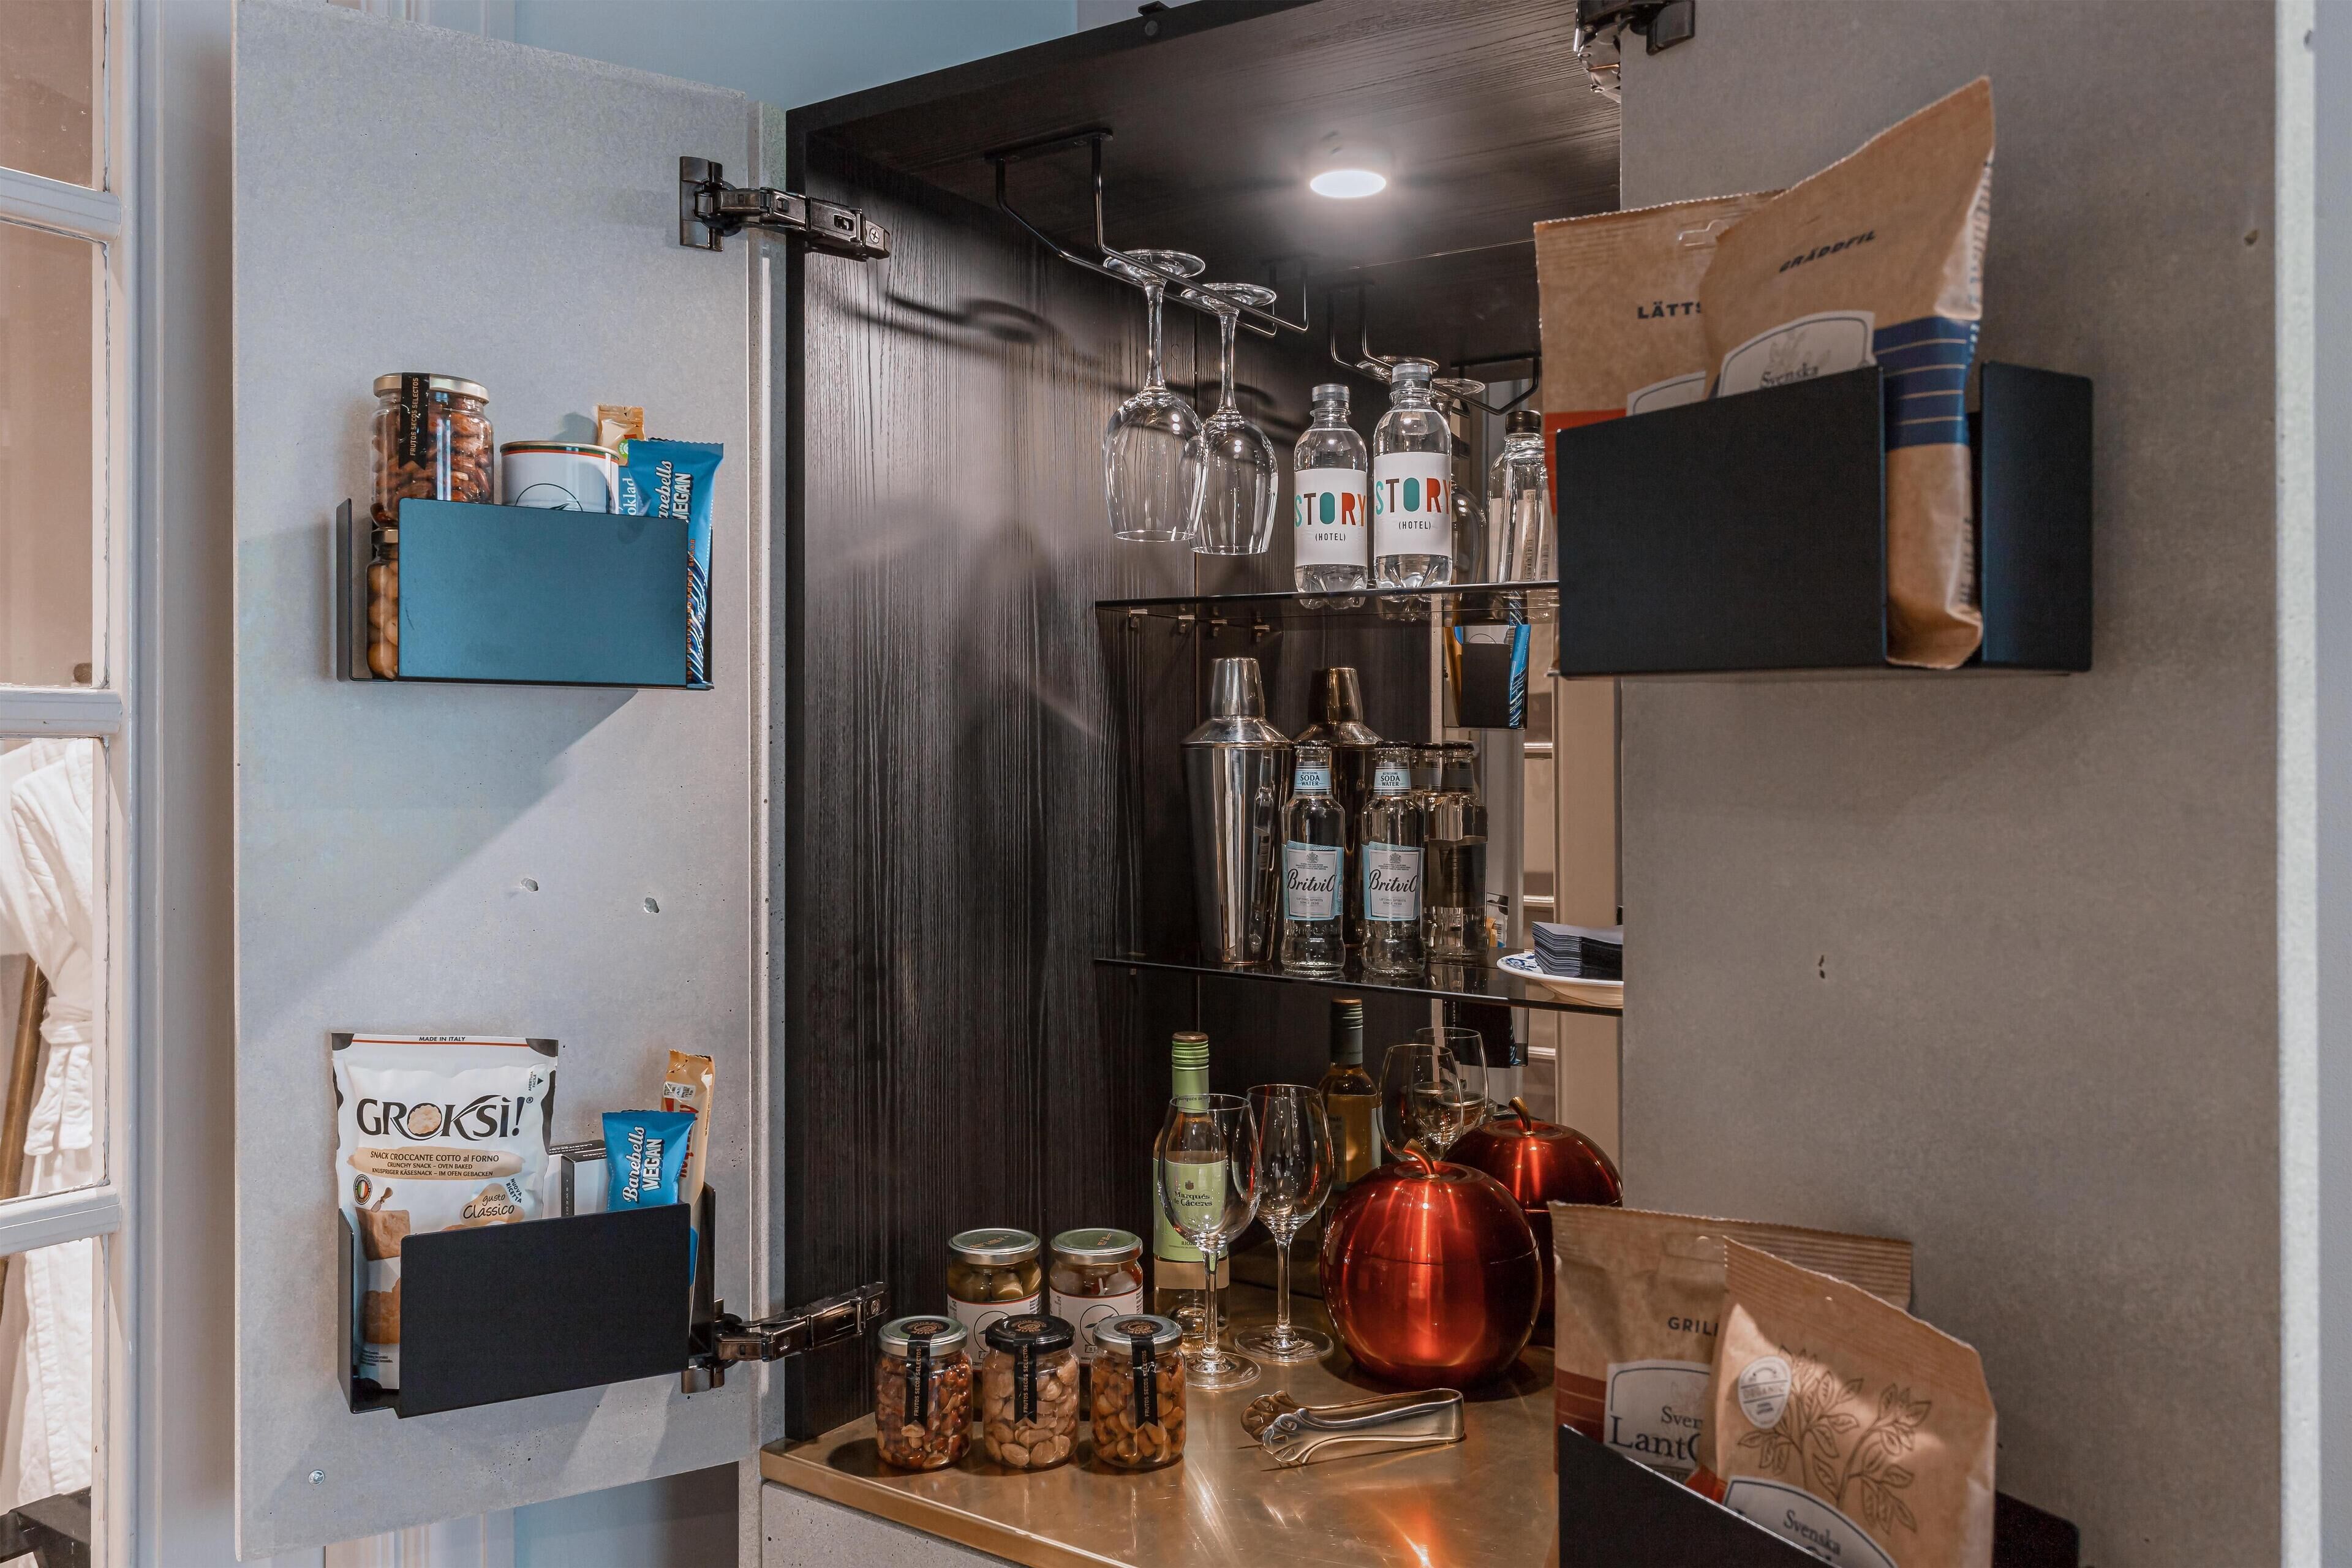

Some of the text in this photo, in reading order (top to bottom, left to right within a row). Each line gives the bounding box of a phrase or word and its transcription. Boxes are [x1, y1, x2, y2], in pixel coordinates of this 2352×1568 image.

[619, 478, 637, 516] oklad
[655, 460, 673, 519] arebells
[1375, 477, 1451, 516] STORY
[1294, 491, 1367, 527] STORY
[1398, 520, 1432, 530] (HOTEL)
[1314, 532, 1347, 541] (HOTEL)
[370, 1151, 389, 1159] SNACK
[390, 1153, 433, 1162] CROCCANTE
[621, 1126, 646, 1204] Barebells
[641, 1138, 664, 1192] VEGAN
[505, 1182, 522, 1204] RICETTA
[510, 1178, 522, 1197] NUOVA
[1174, 1190, 1210, 1200] Marqués
[462, 1203, 515, 1219] Classico
[482, 1194, 506, 1207] gusto
[1782, 1509, 1842, 1556] Svenska
